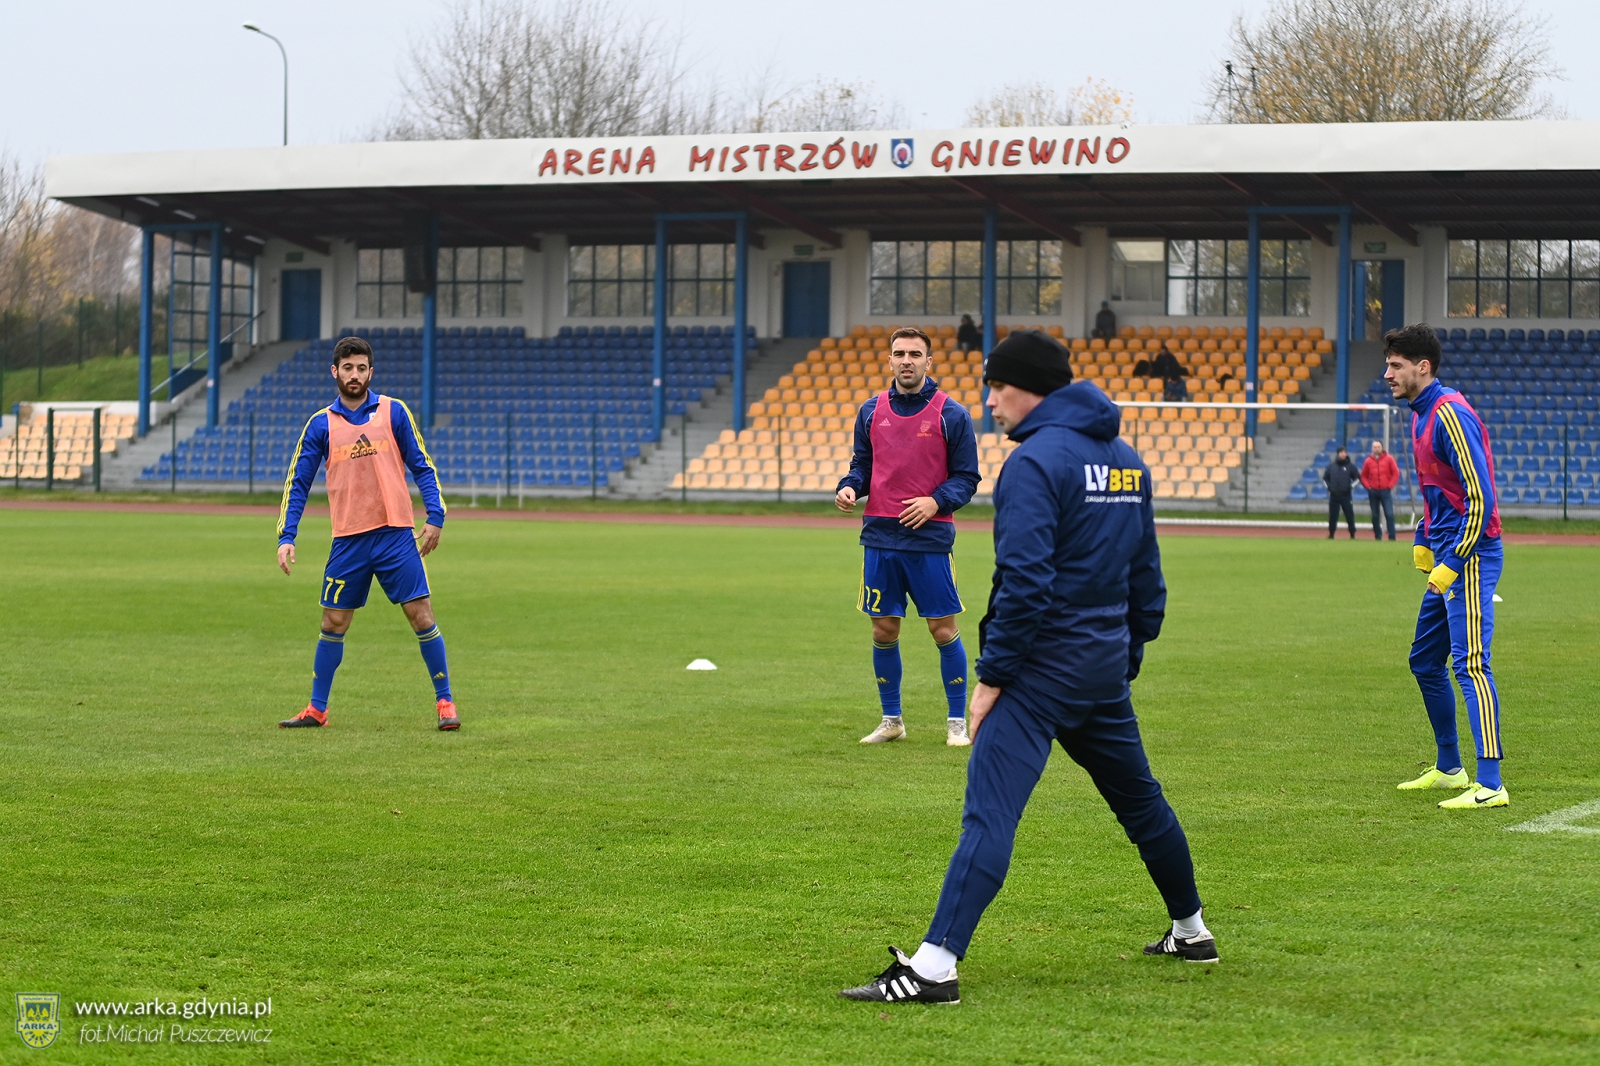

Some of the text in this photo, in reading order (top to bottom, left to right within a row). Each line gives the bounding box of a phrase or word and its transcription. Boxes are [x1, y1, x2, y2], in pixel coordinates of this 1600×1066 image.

[538, 136, 1131, 177] ARENA MISTRZÓW GNIEWINO
[350, 448, 378, 460] adidas
[323, 576, 346, 604] 77
